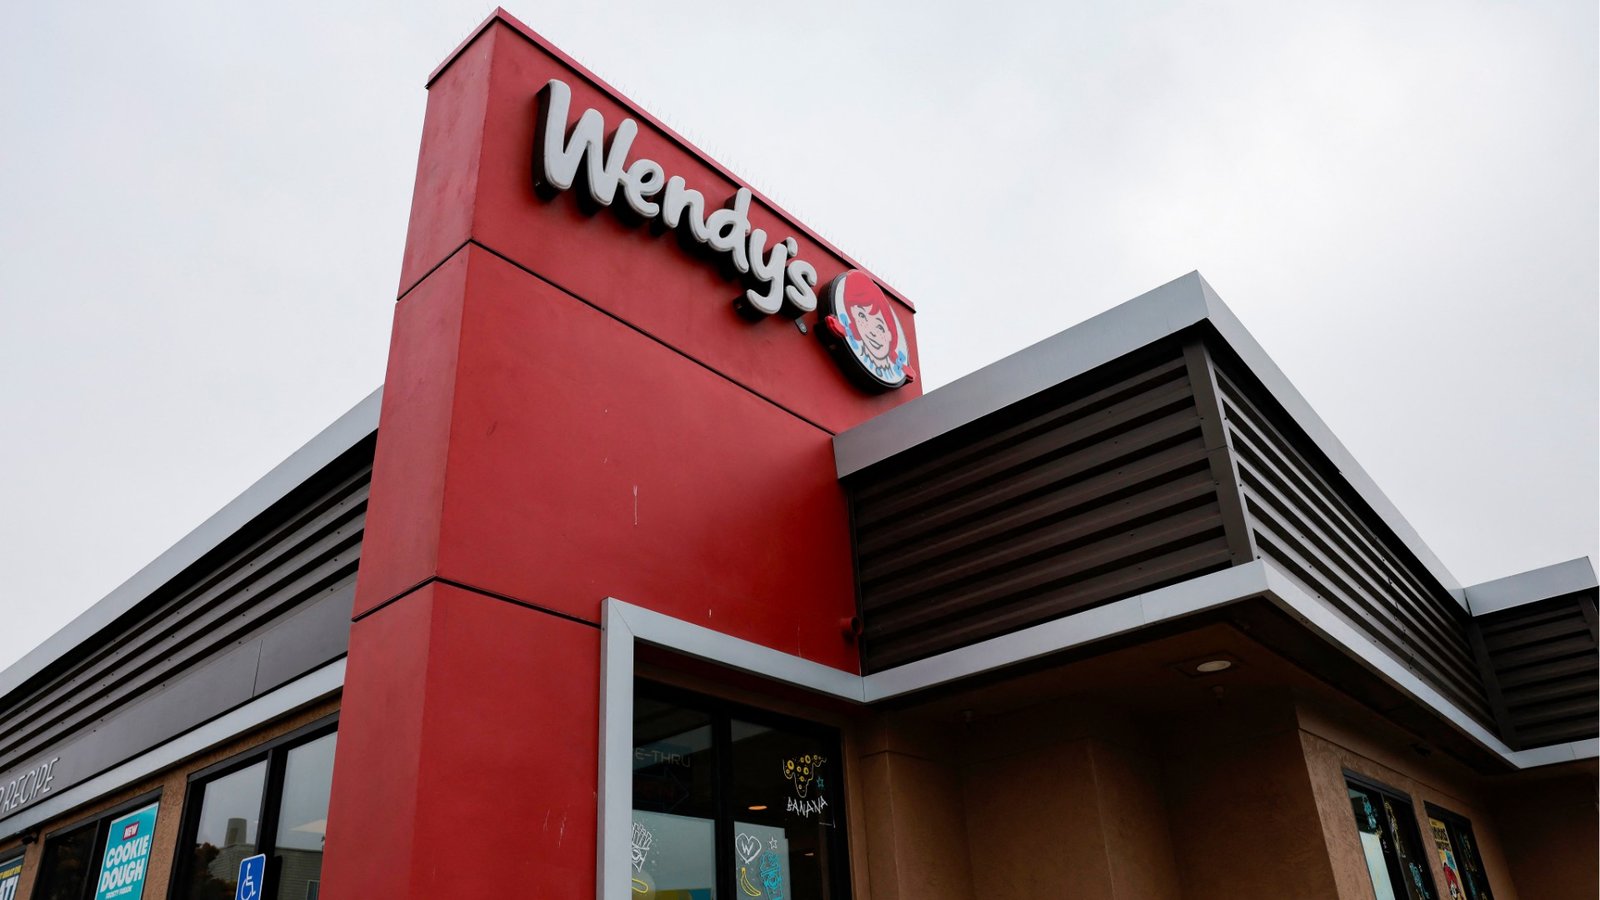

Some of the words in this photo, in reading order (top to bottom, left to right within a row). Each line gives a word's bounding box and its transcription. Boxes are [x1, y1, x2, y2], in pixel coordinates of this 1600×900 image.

[539, 78, 818, 315] Wendy's
[2, 757, 59, 813] RECIPE
[786, 795, 828, 818] BANANA
[123, 824, 139, 839] NEW
[741, 841, 754, 856] W
[106, 834, 150, 869] COOKIE
[100, 857, 146, 893] DOUGH
